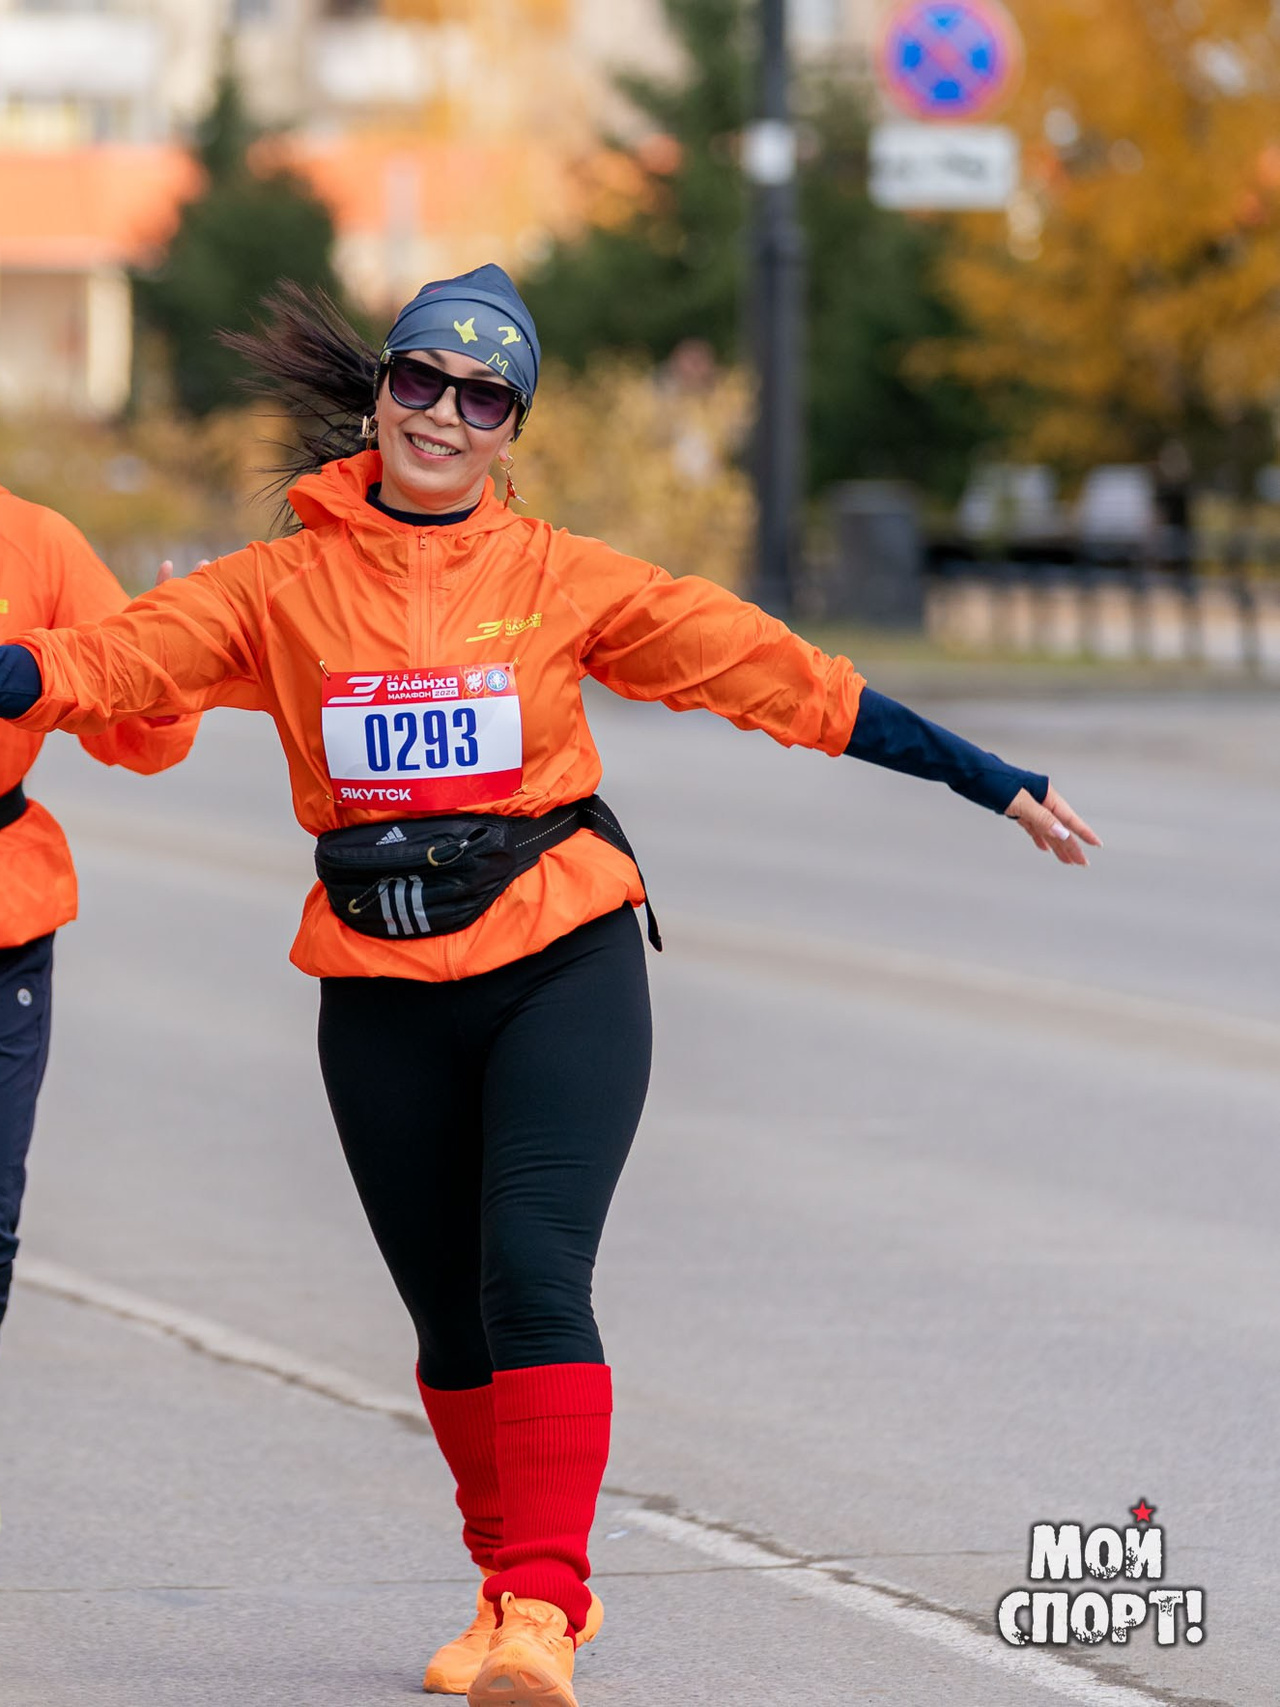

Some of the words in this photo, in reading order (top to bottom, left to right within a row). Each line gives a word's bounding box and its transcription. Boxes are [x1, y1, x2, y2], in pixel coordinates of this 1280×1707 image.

[386, 672, 433, 681] ЗАБЕГ
[387, 677, 458, 692] ОЛОНХО
[388, 691, 431, 700] МАРАФОН
[365, 708, 479, 772] 0293
[340, 788, 412, 801] ЯКУТСК
